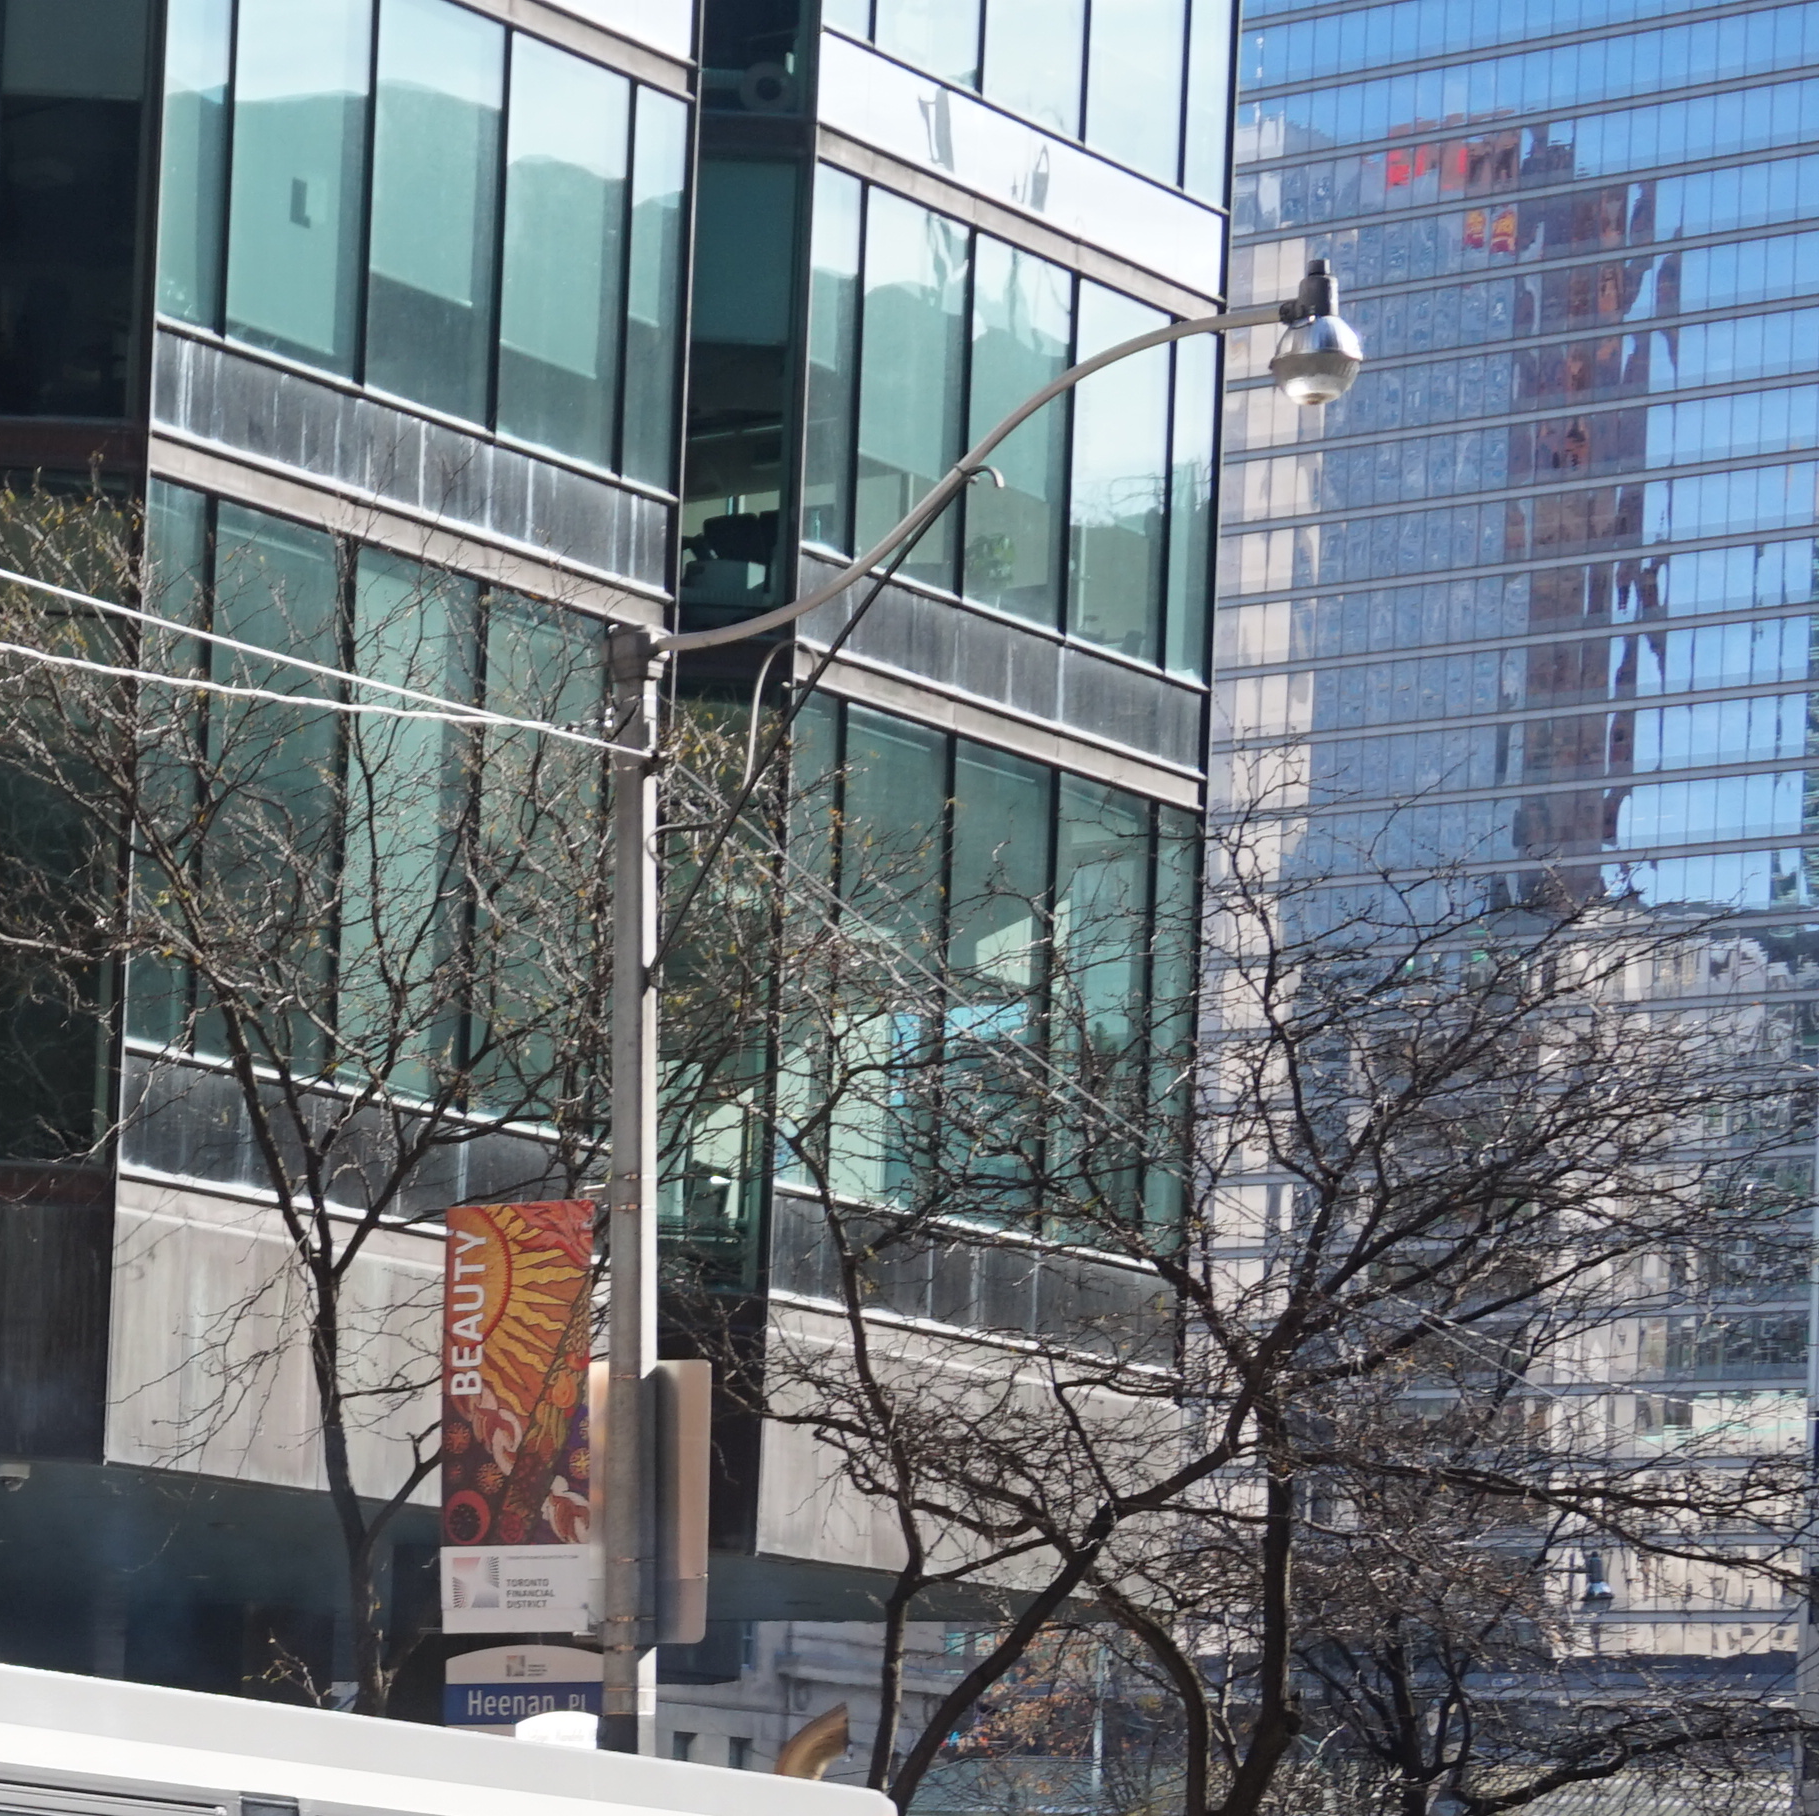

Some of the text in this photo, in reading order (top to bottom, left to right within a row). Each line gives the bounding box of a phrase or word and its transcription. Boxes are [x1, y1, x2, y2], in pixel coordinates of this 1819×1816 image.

[450, 1229, 488, 1396] BEAUTY
[506, 1578, 550, 1587] TORONTO
[506, 1589, 555, 1598] FINANCIAL
[506, 1599, 547, 1608] DISTRICT
[467, 1690, 555, 1716] Heenan
